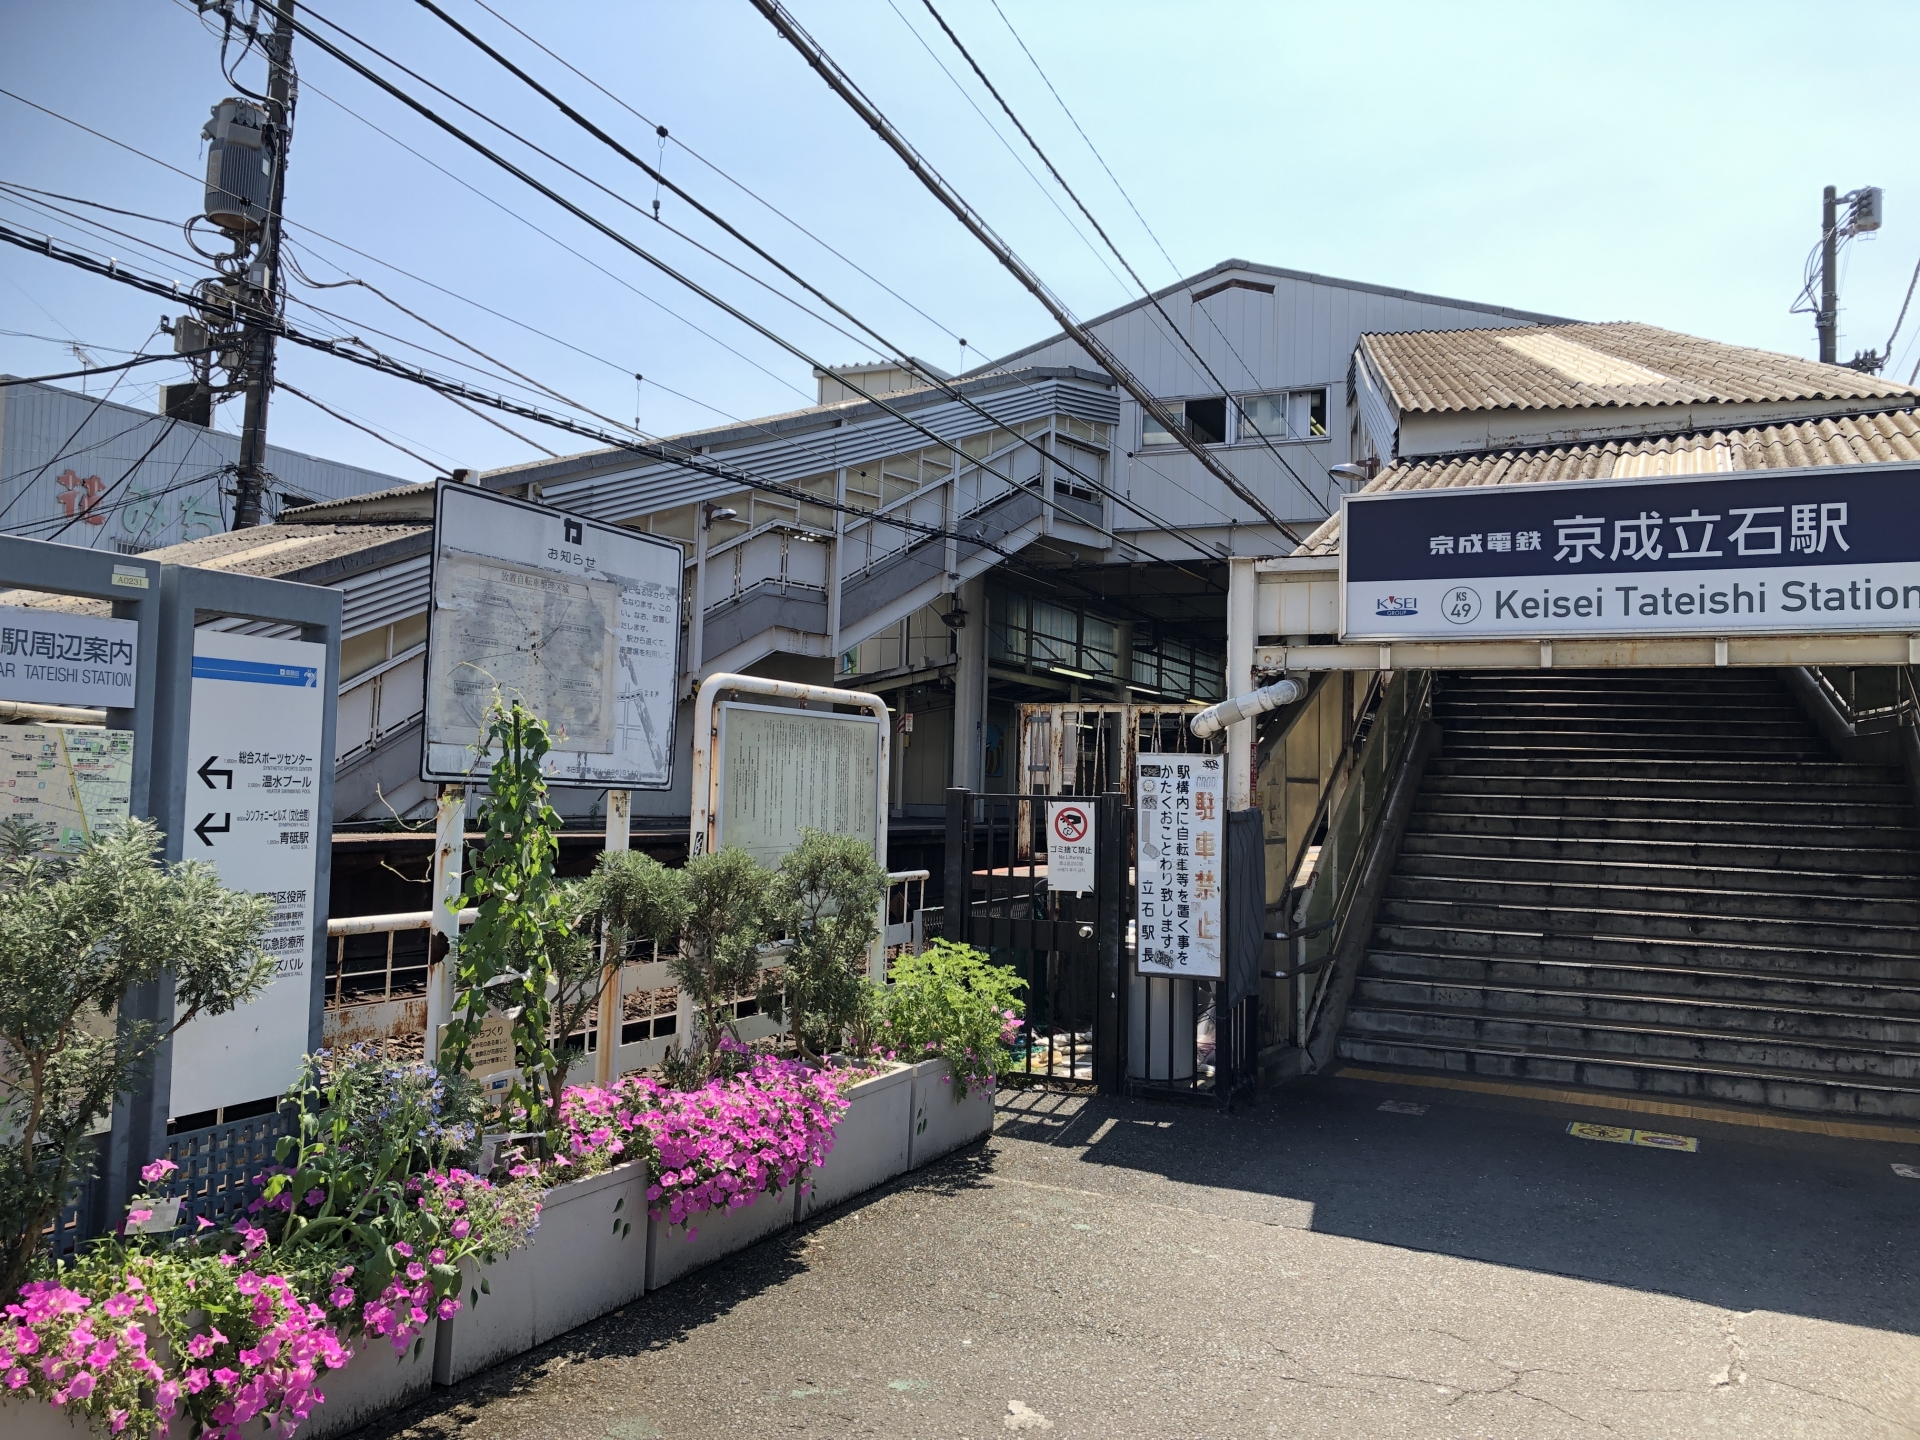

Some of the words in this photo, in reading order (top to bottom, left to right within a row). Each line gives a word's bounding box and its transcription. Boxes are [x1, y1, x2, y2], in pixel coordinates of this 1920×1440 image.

[1430, 531, 1542, 554] 京成電鉄
[1553, 502, 1850, 563] 京成立石駅
[548, 548, 596, 568] お知らせ
[118, 576, 142, 586] A0231
[1456, 591, 1467, 601] KS
[1496, 587, 1602, 619] Keisei
[1616, 582, 1765, 616] Tateishi
[1780, 578, 1920, 612] Station
[1450, 603, 1472, 618] 49
[1, 628, 132, 666] 駅周辺案内
[24, 664, 78, 682] TATEISHI
[82, 669, 132, 687] STATION
[238, 751, 312, 765] 総合スポーツセンター
[262, 775, 312, 788] 温水プール
[280, 832, 309, 844] 青砥駅
[1050, 846, 1092, 854] ゴミ捨て禁止
[1160, 764, 1174, 954] かたくおことわり致します。
[1176, 764, 1190, 965] 駅構内に自転車等を置く事を
[1194, 792, 1215, 939] 駐車禁止
[1141, 880, 1155, 962] 立石駅長
